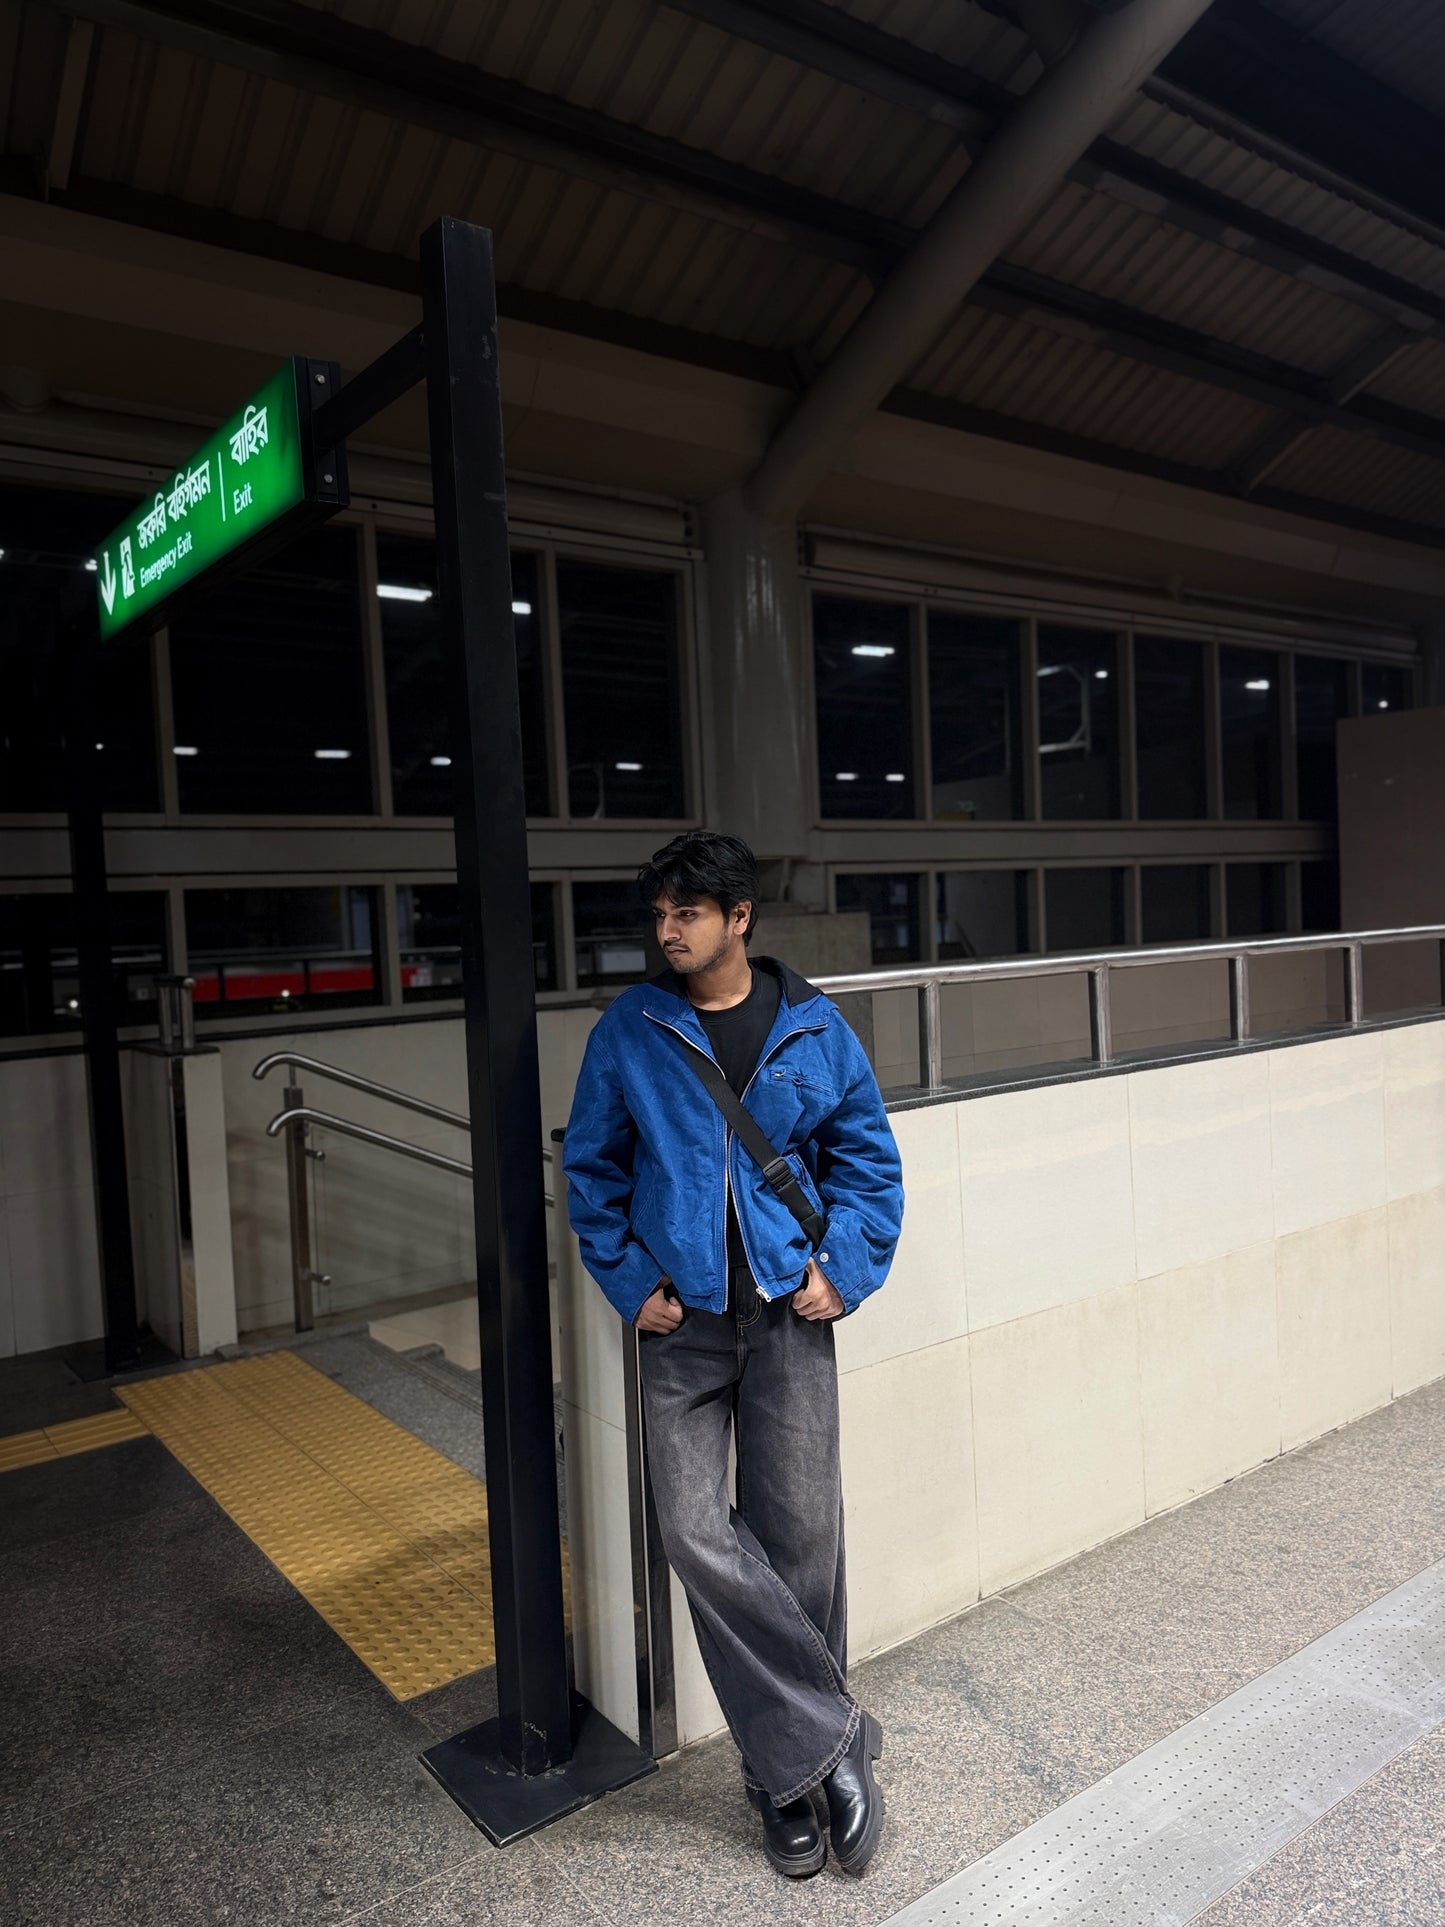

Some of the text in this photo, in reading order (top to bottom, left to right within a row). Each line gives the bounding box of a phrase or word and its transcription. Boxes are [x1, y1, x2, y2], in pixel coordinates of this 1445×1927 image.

[229, 405, 268, 466] বাহির
[137, 460, 211, 549] জরুরি বহির্গমন
[233, 482, 253, 515] Exit
[140, 531, 193, 588] Emergency Exit
